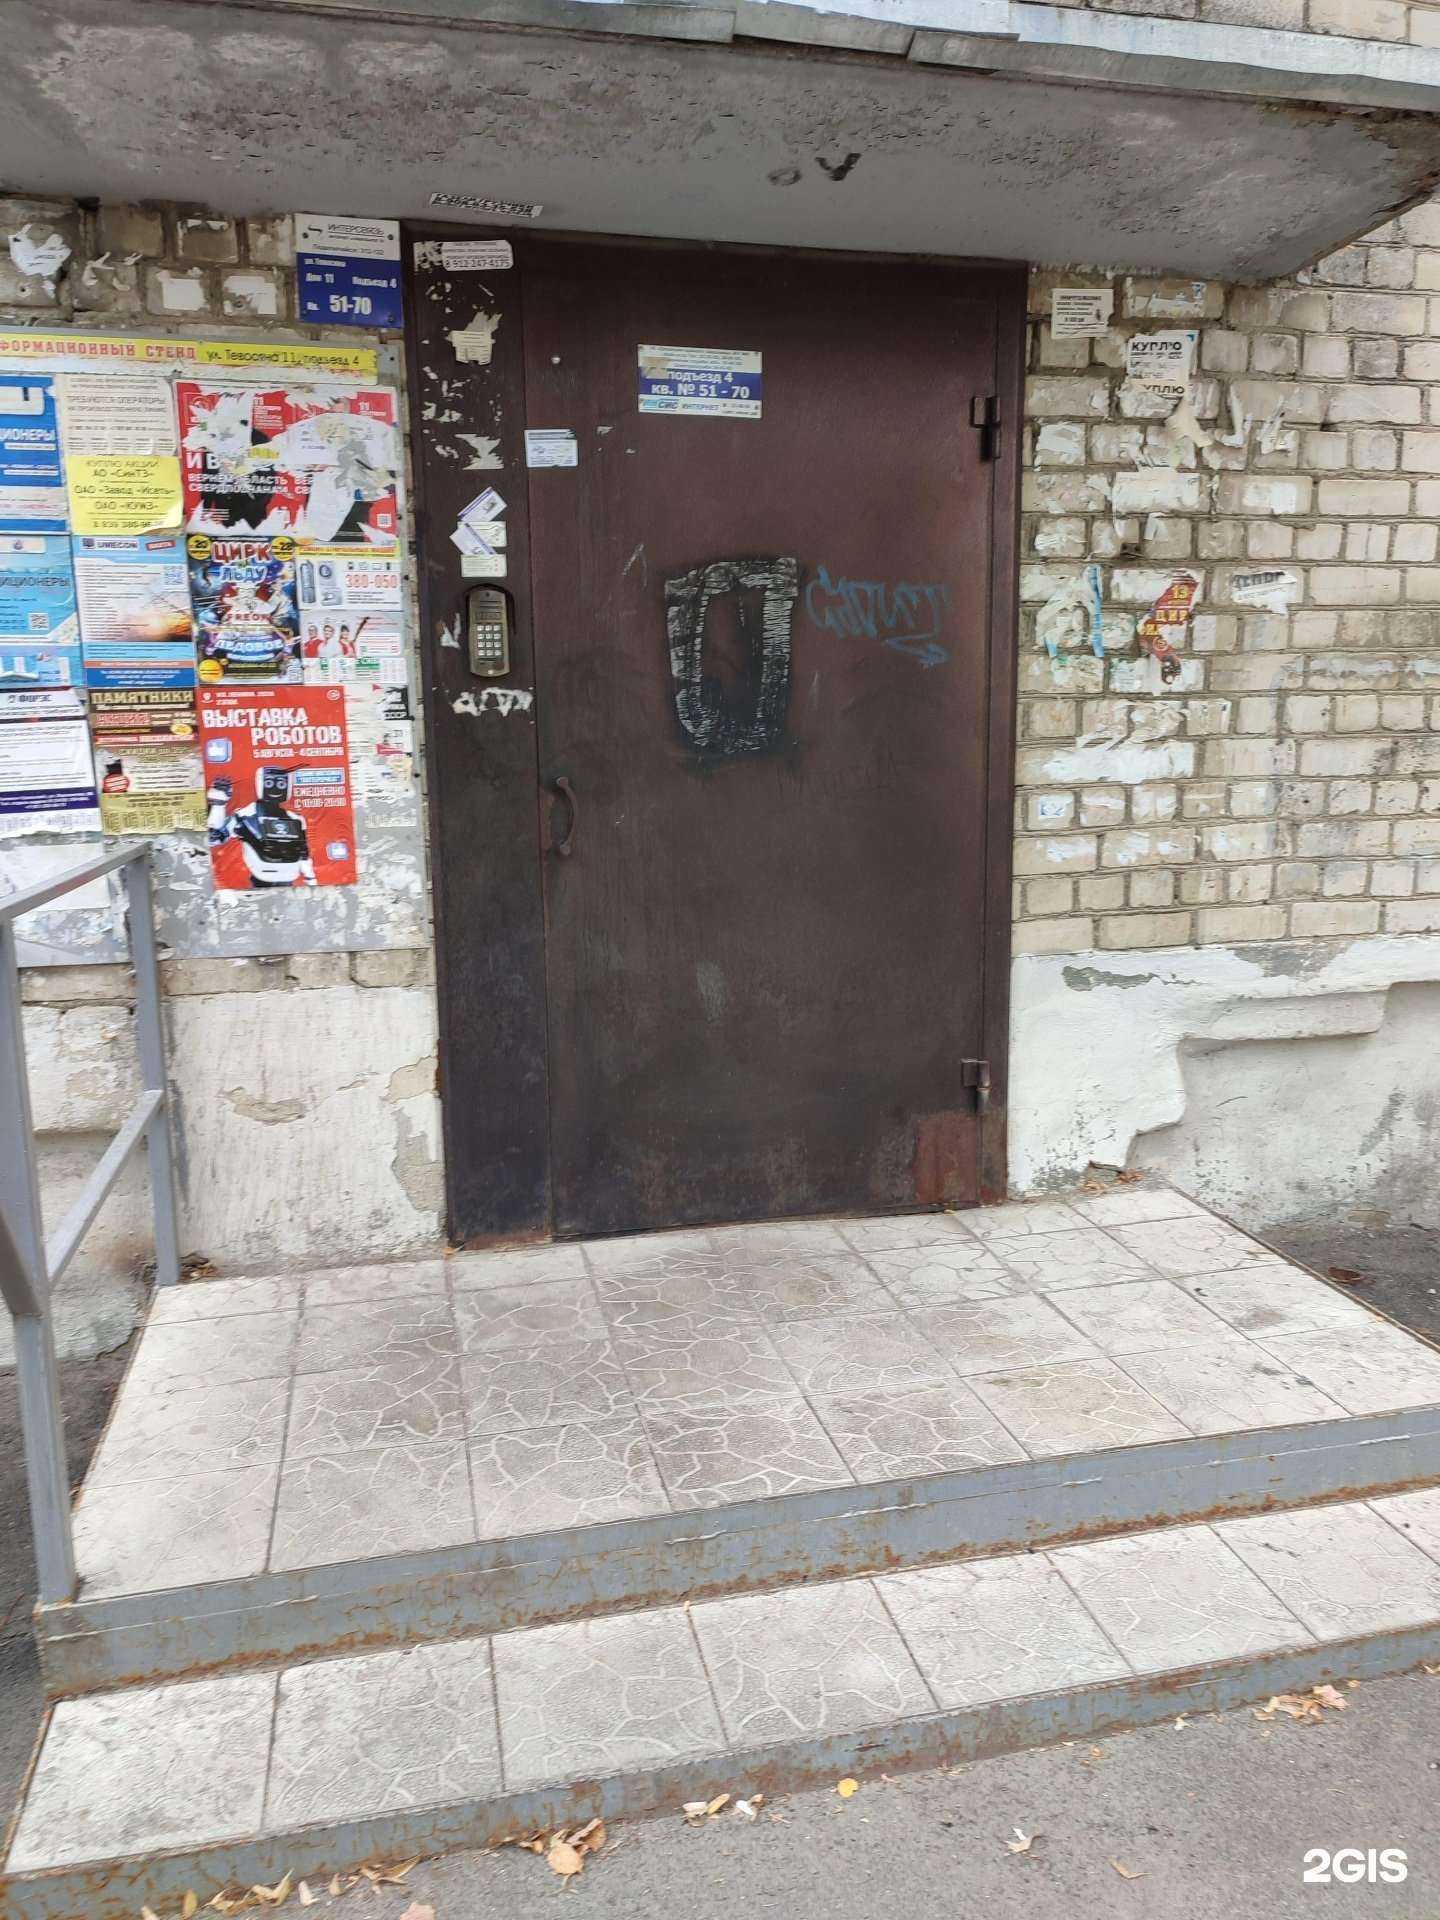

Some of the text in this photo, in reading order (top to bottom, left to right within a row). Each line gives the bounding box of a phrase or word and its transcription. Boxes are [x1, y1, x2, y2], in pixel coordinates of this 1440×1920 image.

[329, 294, 373, 315] 51-70
[145, 345, 196, 359] СТЕНД
[352, 355, 360, 365] 4
[668, 370, 733, 384] подъезд 4
[651, 384, 674, 394] кв.
[677, 383, 696, 396] №
[699, 385, 718, 397] 51
[731, 386, 750, 399] 70
[186, 453, 203, 469] И
[212, 541, 273, 563] ЦИРК
[221, 567, 267, 582] ЛЬДУ
[345, 574, 398, 589] 380-050
[90, 690, 194, 704] ПАМЯТНИКИ
[202, 707, 308, 728] ВЫСТАВКА
[251, 725, 342, 746] РОБОТОВ
